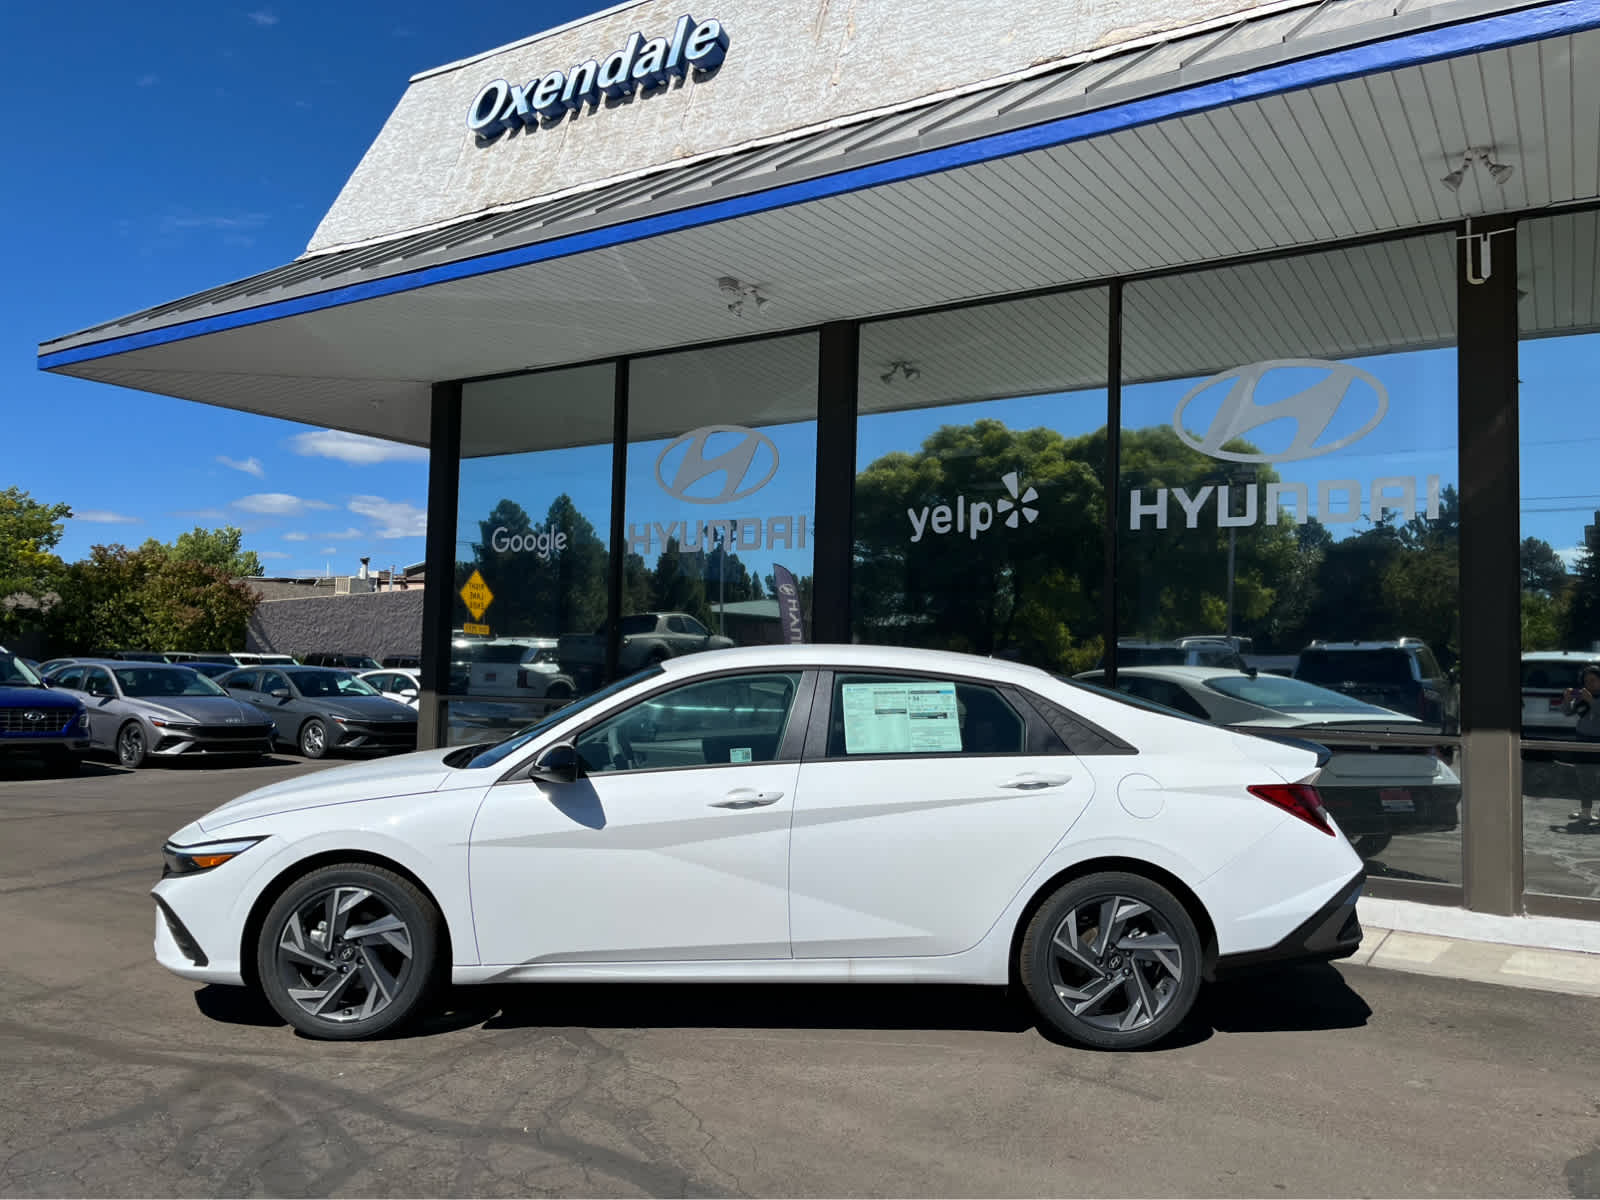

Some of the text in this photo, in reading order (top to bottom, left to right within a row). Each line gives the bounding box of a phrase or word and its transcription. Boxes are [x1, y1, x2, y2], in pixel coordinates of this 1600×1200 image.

[466, 14, 729, 138] Oxendale
[907, 496, 993, 542] yelp
[1129, 473, 1442, 532] HYUNDAI
[491, 524, 567, 560] Google
[627, 516, 807, 556] HYUNDAI
